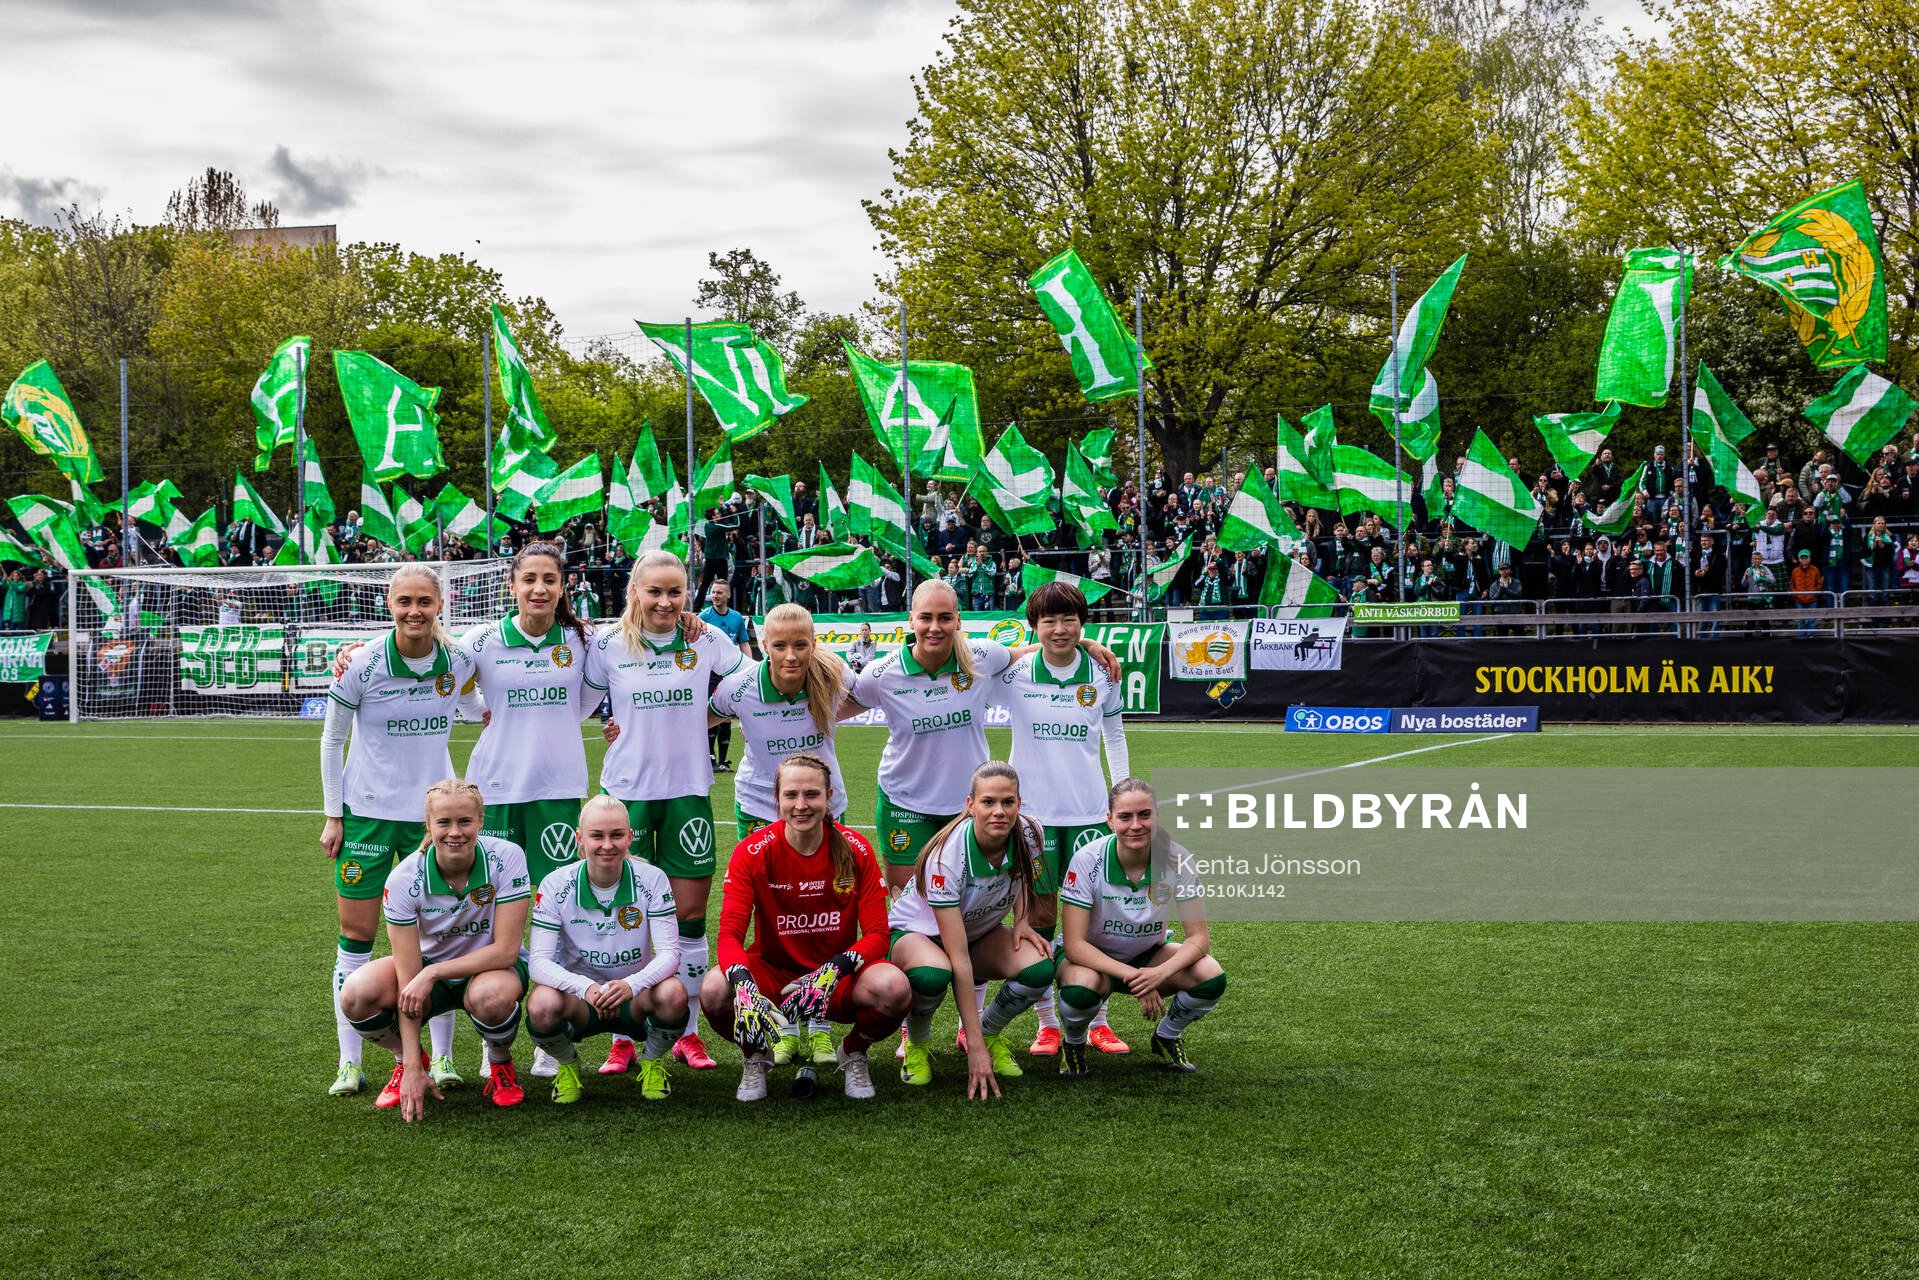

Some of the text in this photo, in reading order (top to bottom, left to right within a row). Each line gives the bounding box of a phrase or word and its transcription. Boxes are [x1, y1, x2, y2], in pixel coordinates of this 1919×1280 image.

[1357, 606, 1458, 618] ANTI VÄSKFÖRBUD
[1256, 622, 1309, 636] BAJEN
[473, 625, 498, 653] Convini
[359, 651, 382, 683] Convini
[1475, 660, 1774, 694] STOCKHOLM ÄR AIK!
[508, 687, 567, 703] PROJOB
[632, 688, 693, 705] PROJOB
[730, 674, 755, 703] Convini
[387, 716, 448, 731] PROJOB
[912, 709, 972, 731] PROJOB
[1326, 714, 1383, 731] OBOS
[1401, 713, 1527, 732] Nya bostäder
[1032, 723, 1088, 737] PROJOB
[767, 732, 824, 750] PROJOB
[344, 841, 390, 852] BOSPHORUS
[747, 830, 776, 855] Convini
[777, 911, 841, 930] PROJOB
[1103, 919, 1163, 934] PROJOB
[811, 926, 840, 934] WORKWEAR
[579, 947, 642, 965] PROJOB
